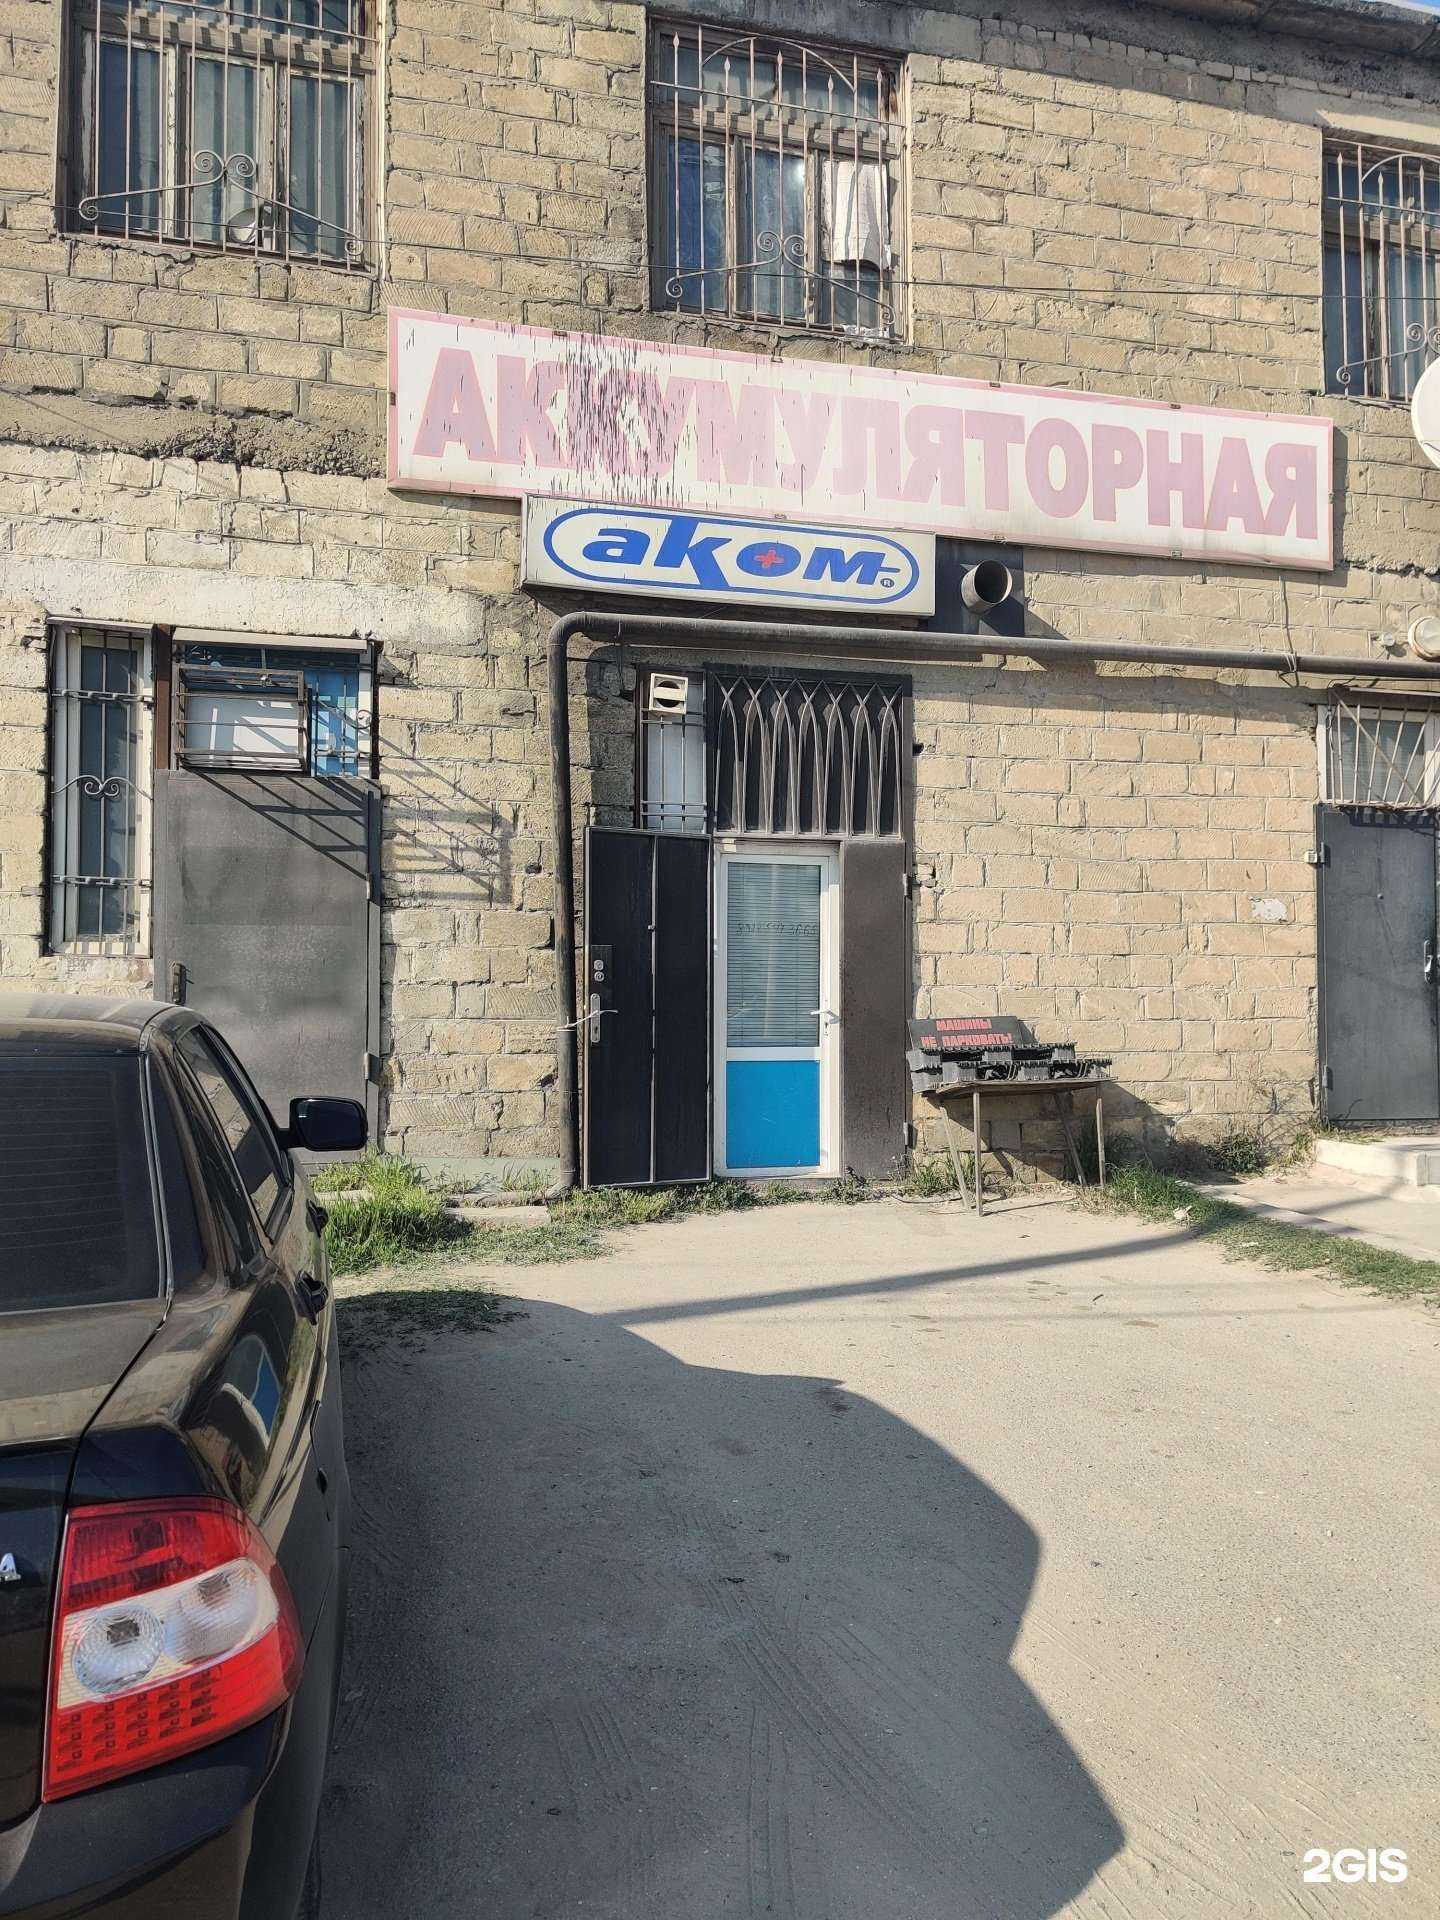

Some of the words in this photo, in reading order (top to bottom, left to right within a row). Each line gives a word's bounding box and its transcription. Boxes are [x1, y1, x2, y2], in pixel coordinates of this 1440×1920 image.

[413, 348, 1318, 540] АККУМУЛЯТОРНАЯ
[936, 1019, 992, 1031] МАШИНЫ
[920, 1036, 938, 1048] НЕ
[942, 1033, 1014, 1047] ПАРКОВАТЬ!
